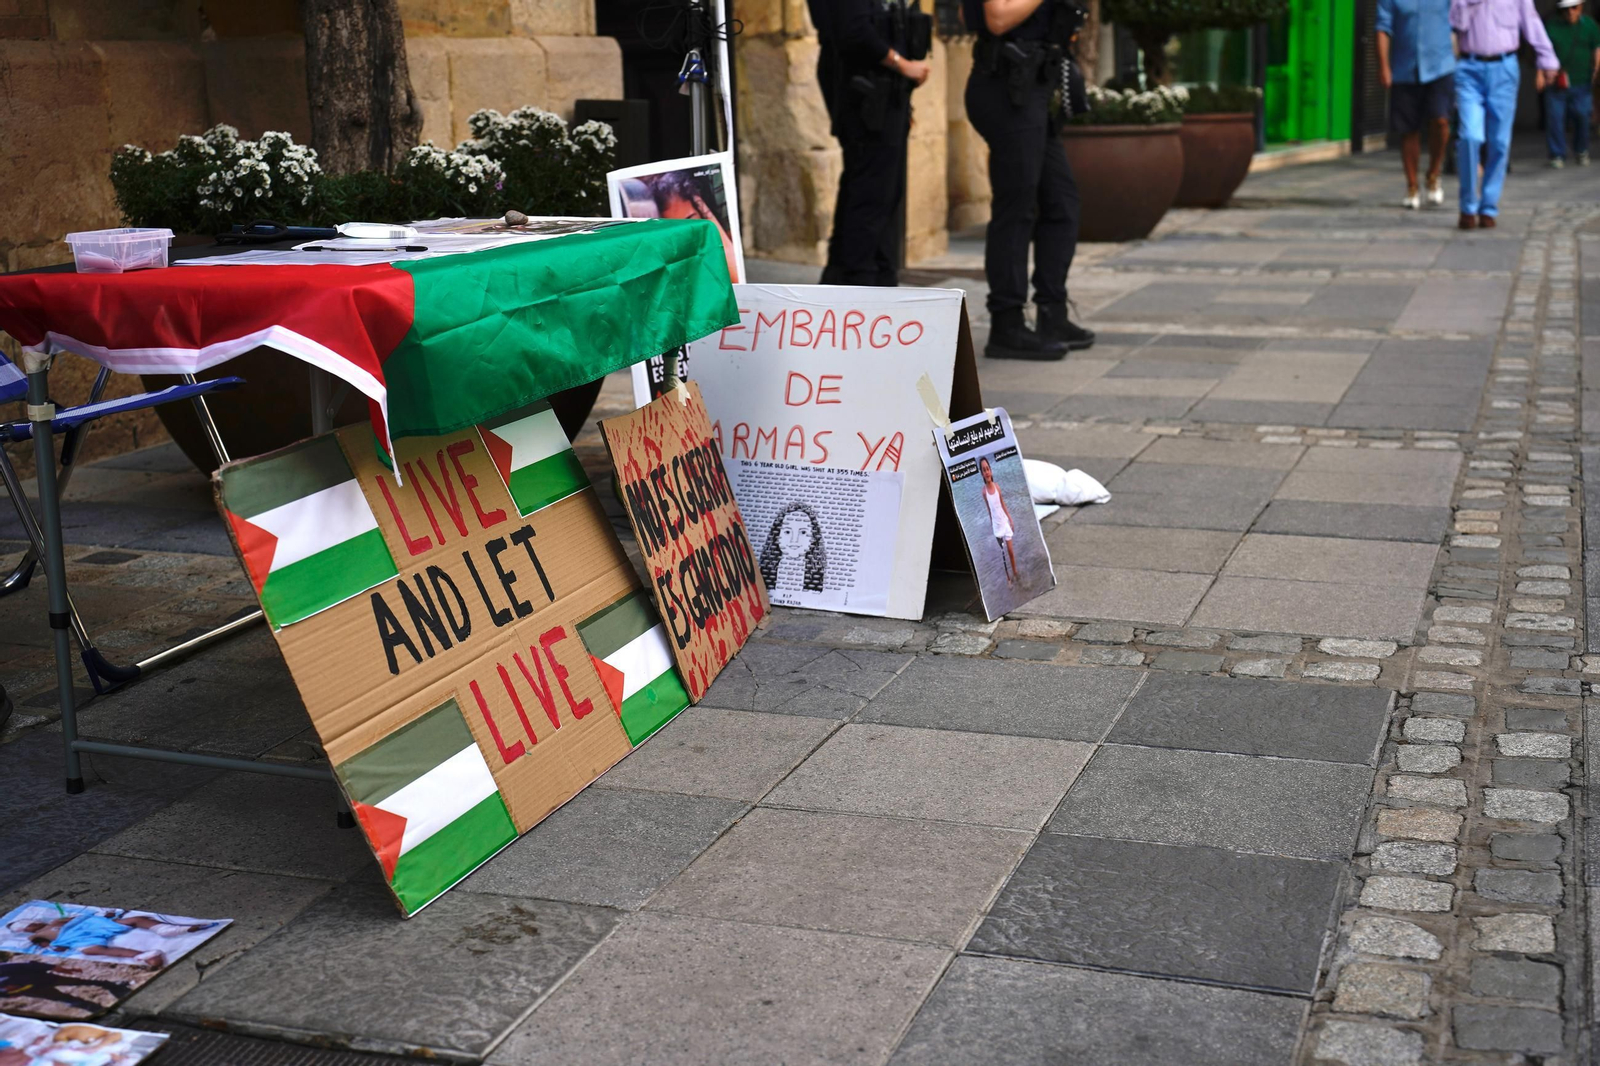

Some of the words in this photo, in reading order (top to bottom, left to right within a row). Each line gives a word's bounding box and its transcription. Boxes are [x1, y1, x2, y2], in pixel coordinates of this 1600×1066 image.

[718, 309, 924, 351] EMBARGO
[784, 370, 843, 406] DE
[376, 439, 507, 556] LIVE
[625, 478, 666, 558] NO
[650, 464, 687, 541] ES
[672, 438, 735, 525] GUERRA
[711, 419, 833, 465] ARMAS
[857, 431, 905, 472] YA
[371, 564, 472, 676] AND
[461, 524, 557, 627] LET
[657, 569, 692, 650] ES
[679, 521, 757, 630] GENOCIDIO
[469, 625, 595, 764] LIVE
